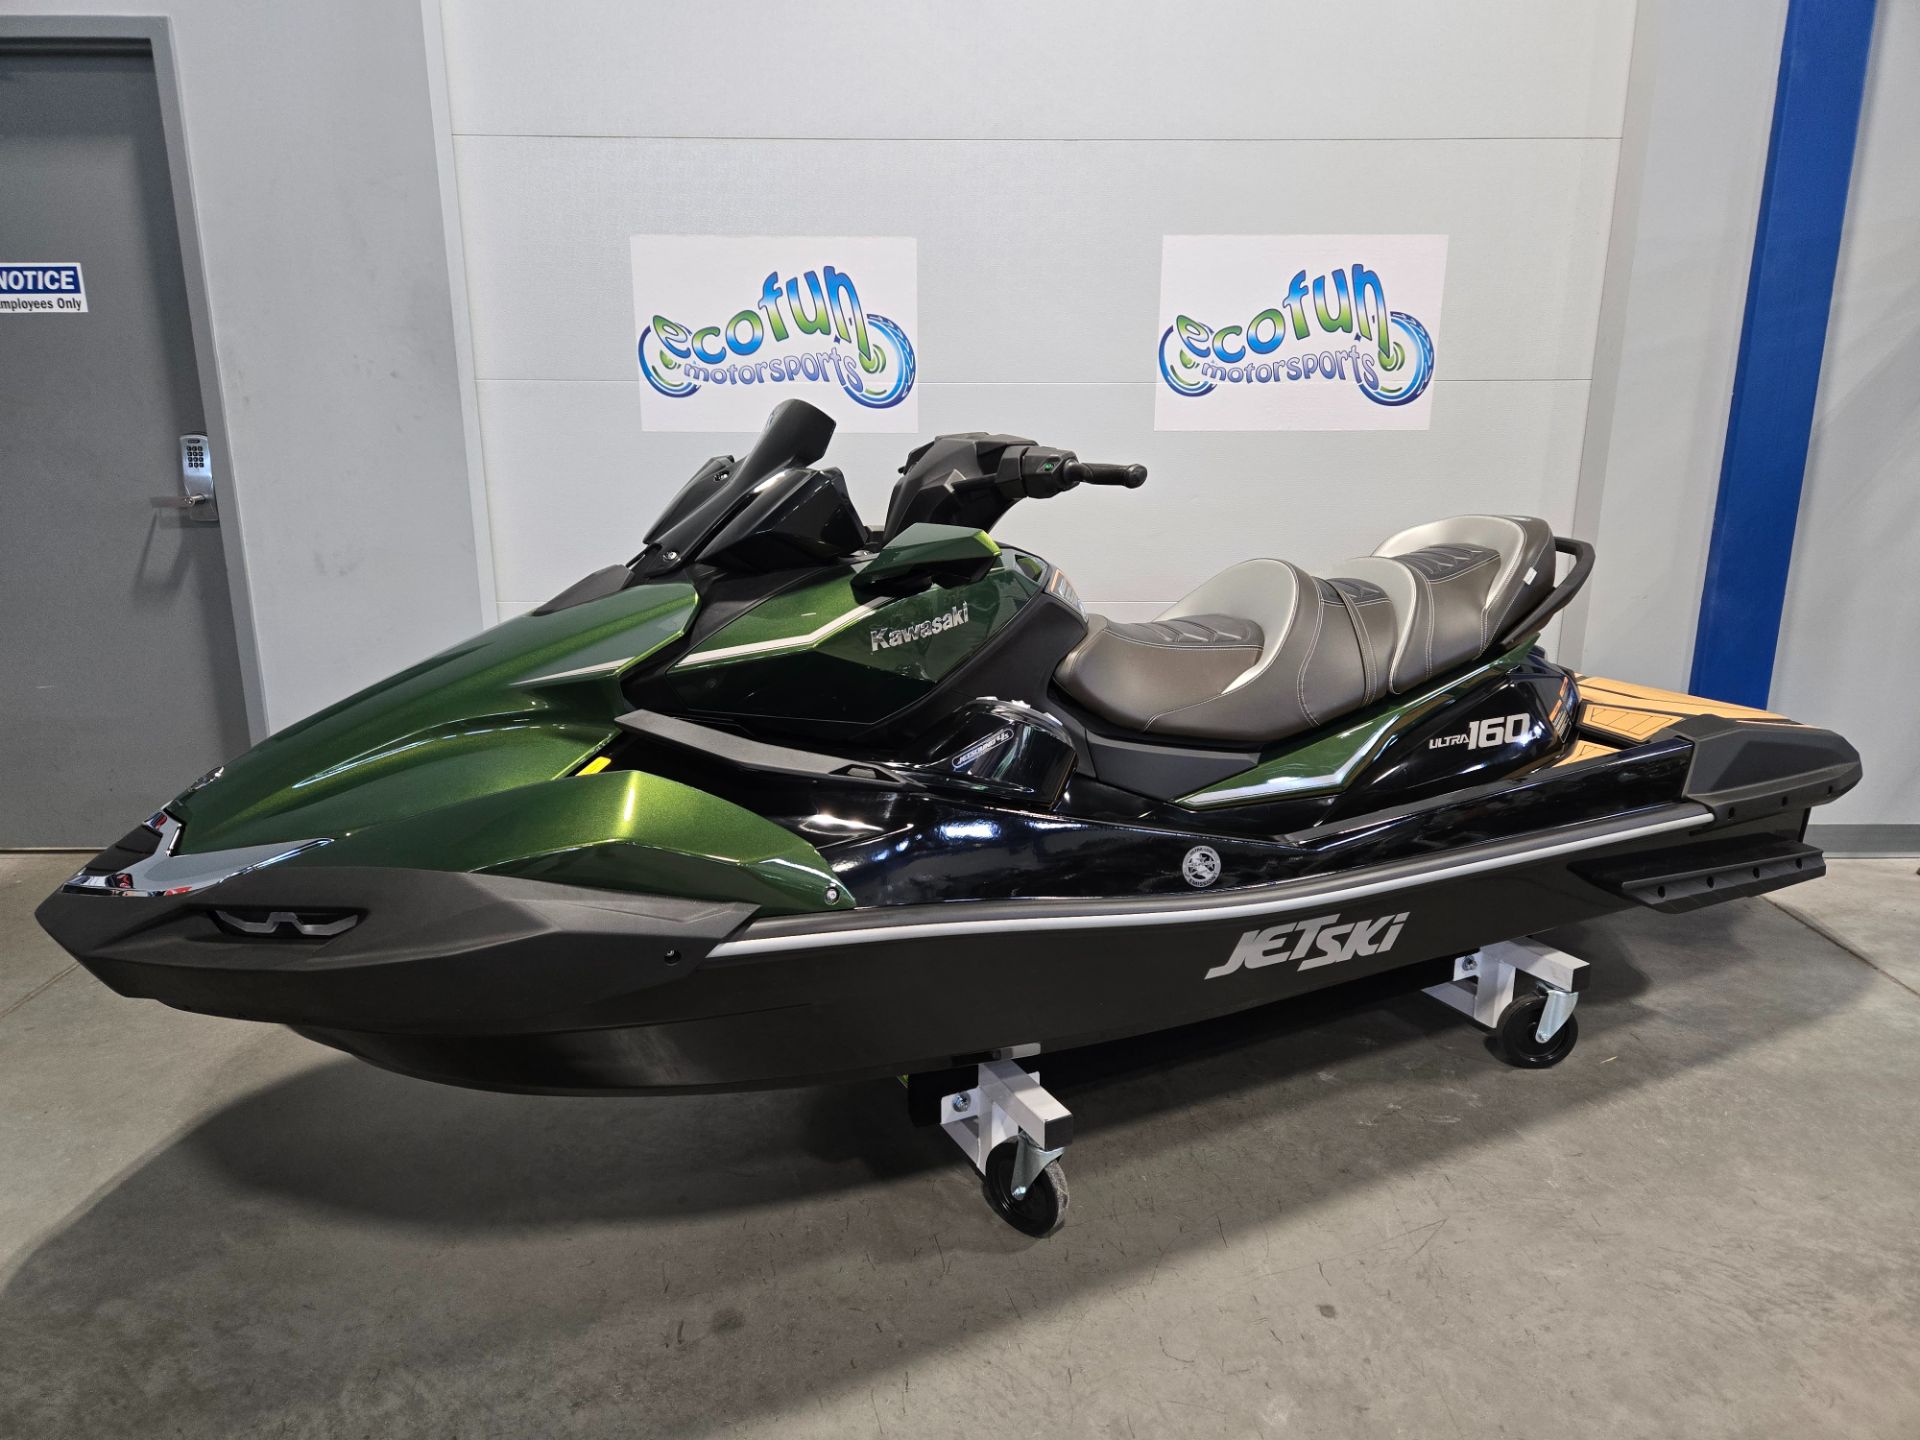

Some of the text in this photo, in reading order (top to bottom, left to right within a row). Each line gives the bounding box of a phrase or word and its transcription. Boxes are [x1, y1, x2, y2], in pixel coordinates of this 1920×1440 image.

[0, 297, 81, 311] mployees Only
[684, 347, 863, 393] motorsports
[1201, 345, 1379, 391] motorsports
[870, 600, 969, 652] Kawasaki
[1429, 733, 1470, 750] ULTRA
[1468, 713, 1531, 750] 160
